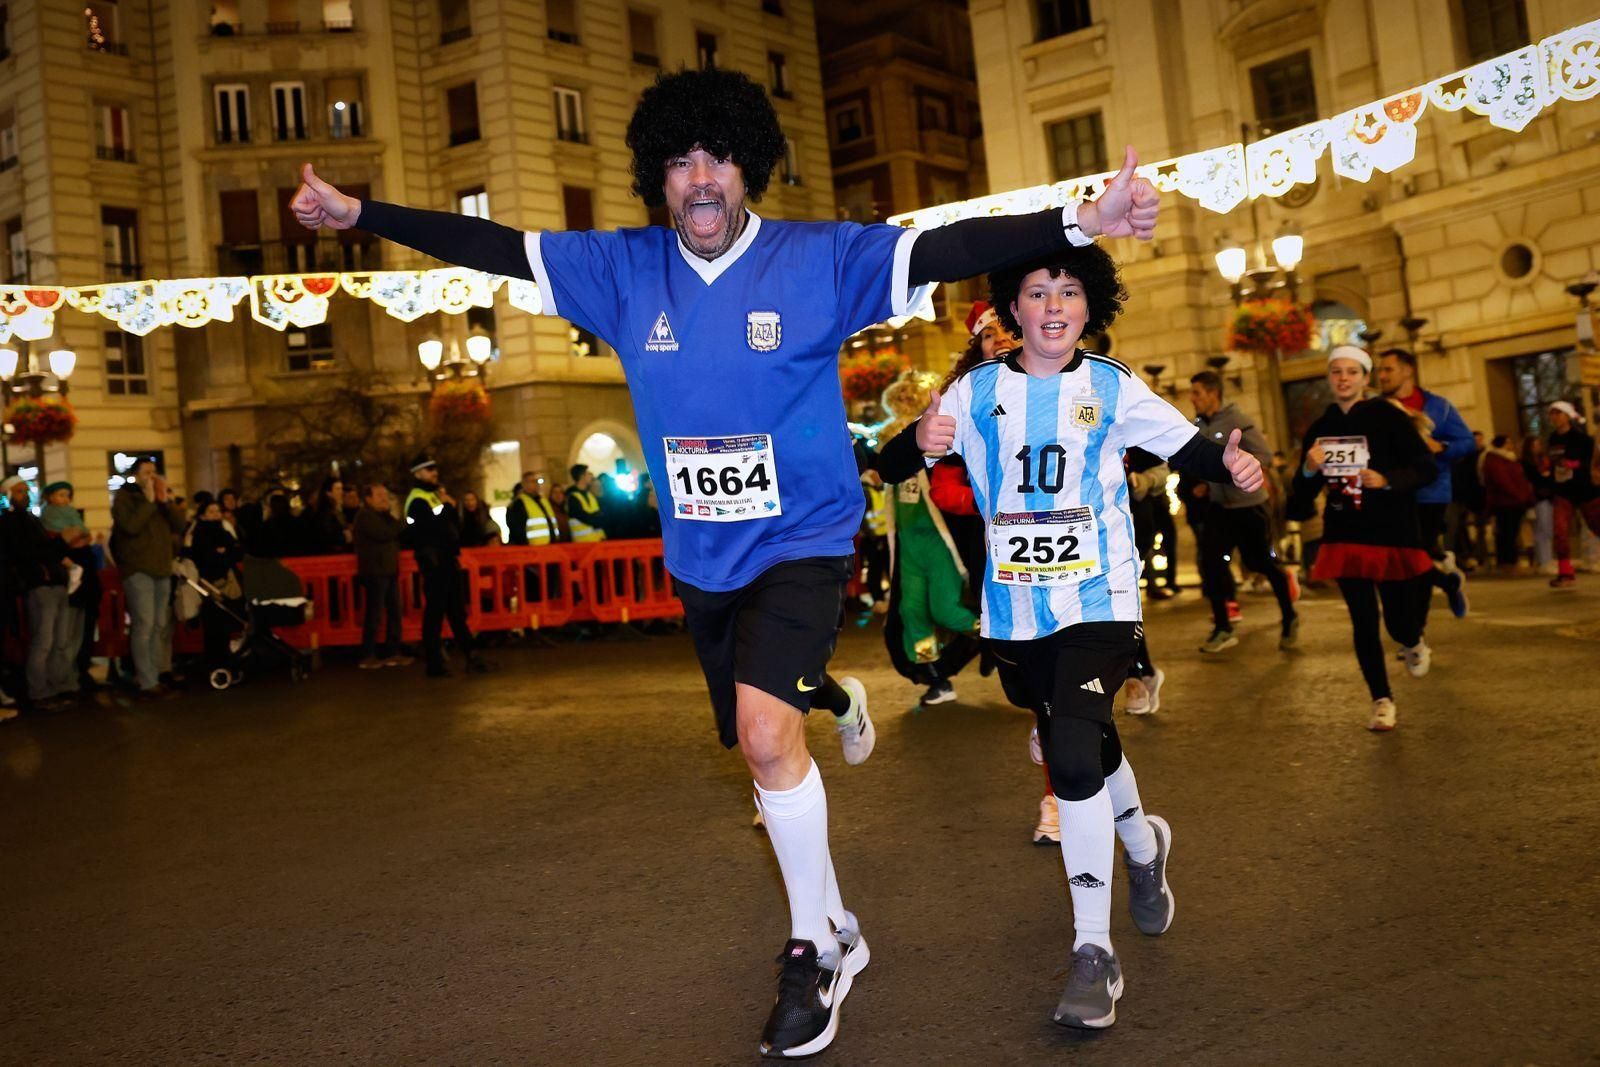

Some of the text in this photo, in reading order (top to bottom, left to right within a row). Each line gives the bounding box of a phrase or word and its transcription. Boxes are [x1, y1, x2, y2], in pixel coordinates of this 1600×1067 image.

[1078, 406, 1095, 423] AFA
[1015, 444, 1067, 494] 10
[1324, 450, 1356, 464] 251
[676, 463, 771, 496] 1664
[1008, 535, 1080, 564] 252
